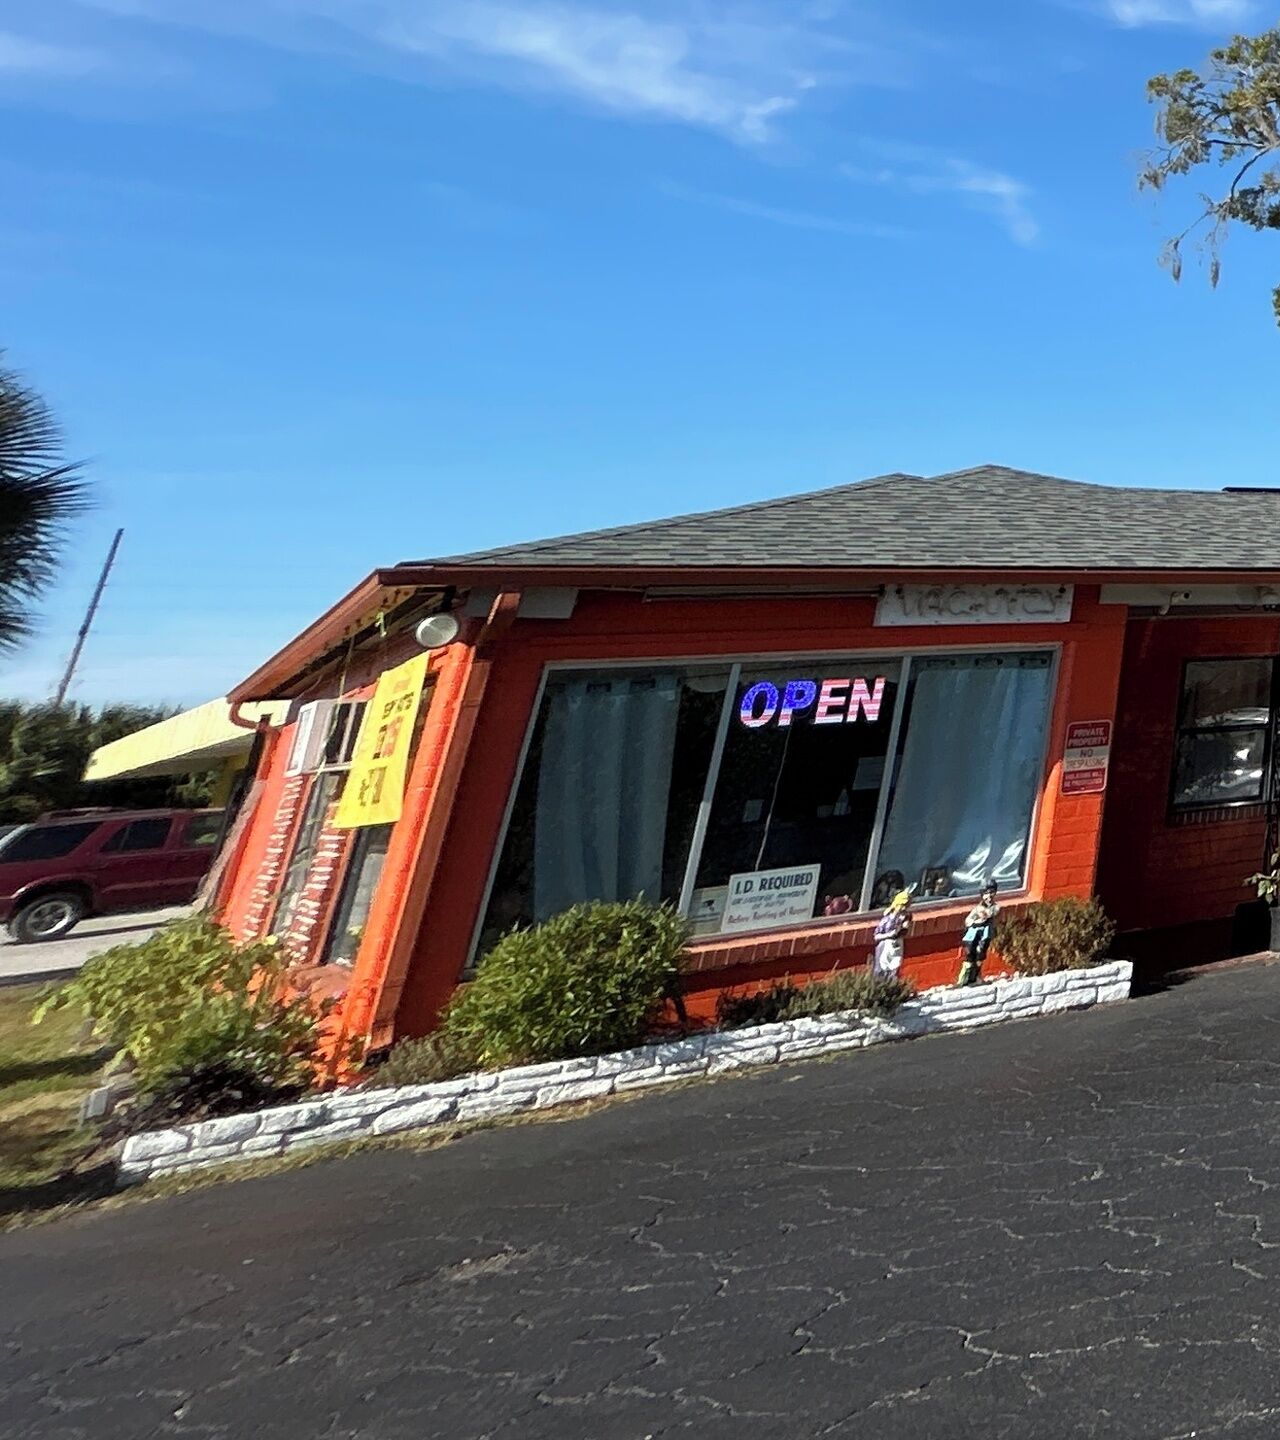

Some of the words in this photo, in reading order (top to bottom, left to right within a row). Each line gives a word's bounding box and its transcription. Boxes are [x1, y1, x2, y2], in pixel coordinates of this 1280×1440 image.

[740, 675, 886, 728] OPEN
[1067, 736, 1108, 747] PROPERTY
[1079, 748, 1094, 758] NO
[759, 872, 813, 891] REQUIRED
